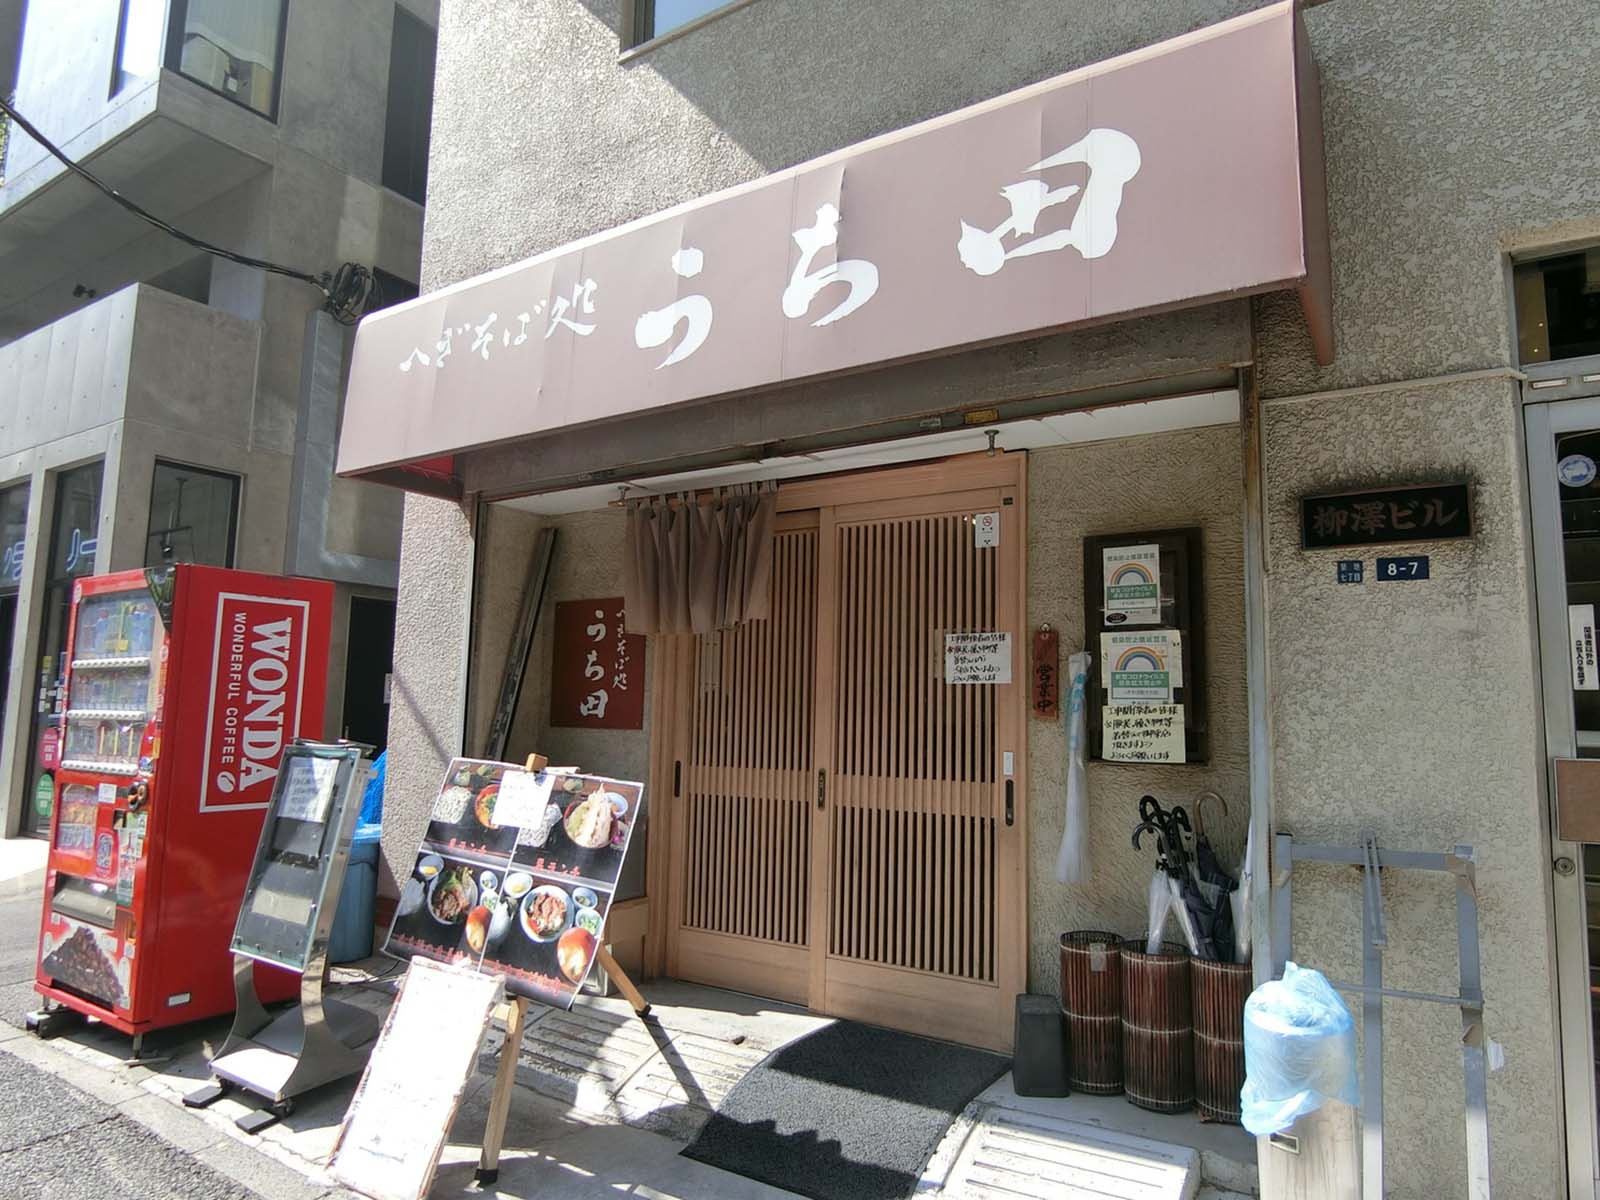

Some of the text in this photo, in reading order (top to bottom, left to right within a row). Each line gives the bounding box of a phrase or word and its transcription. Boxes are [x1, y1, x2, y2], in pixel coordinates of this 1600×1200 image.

[635, 128, 1142, 370] うち田
[1312, 500, 1460, 537] 柳澤ビル
[1387, 561, 1418, 576] 8-7
[221, 612, 247, 764] WONDERFUL COFFEE
[239, 616, 293, 792] WONDA
[580, 609, 609, 719] うち田
